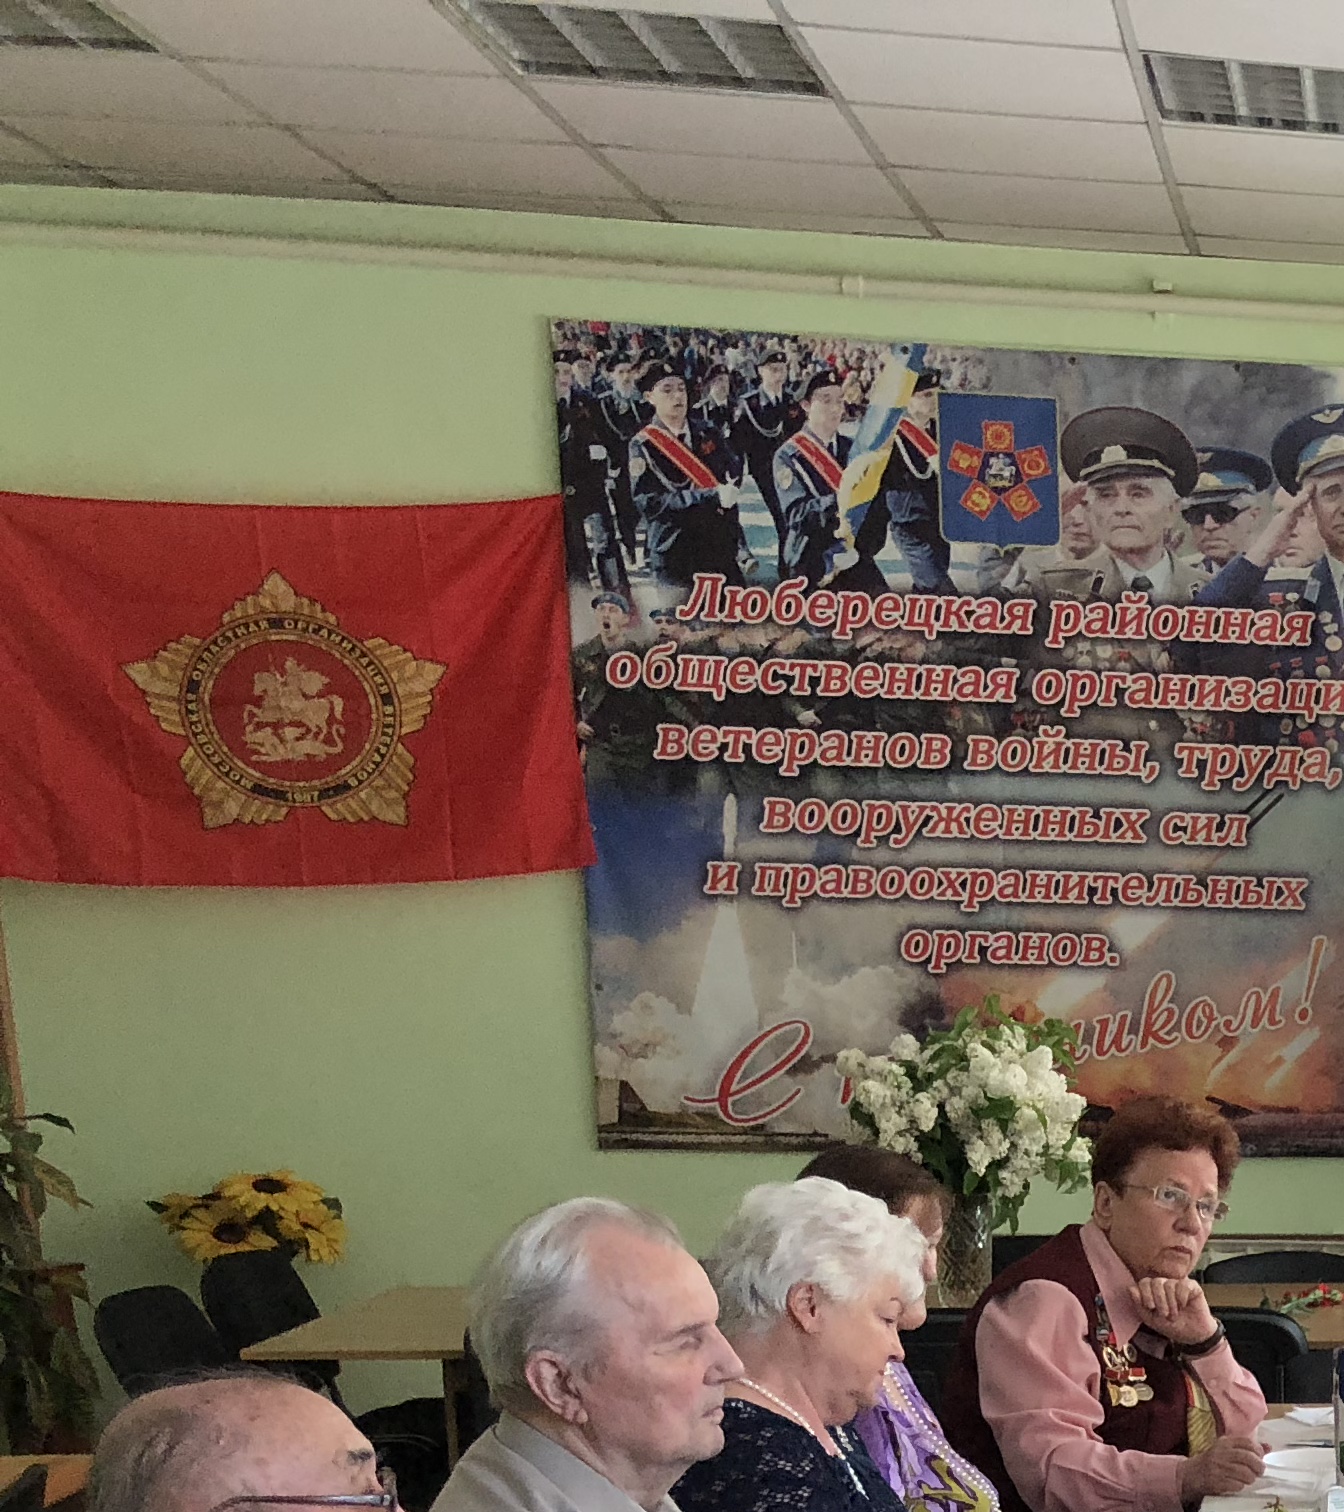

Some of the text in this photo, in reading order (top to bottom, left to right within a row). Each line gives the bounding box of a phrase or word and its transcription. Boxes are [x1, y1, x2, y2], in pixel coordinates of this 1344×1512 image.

[680, 573, 1313, 649] Люберецкая районная
[193, 620, 394, 787] ОБЛАСТНАЯ ОРГАНИЗАЦИЯ ВЕТЕРАНОВ
[607, 644, 1021, 705] общественная
[655, 724, 1343, 790] ветеранов войны, труда,
[761, 797, 1248, 850] вооруженных сил
[704, 863, 1307, 912] и правоохранительных
[901, 926, 1120, 973] органов.
[681, 1018, 813, 1126] С
